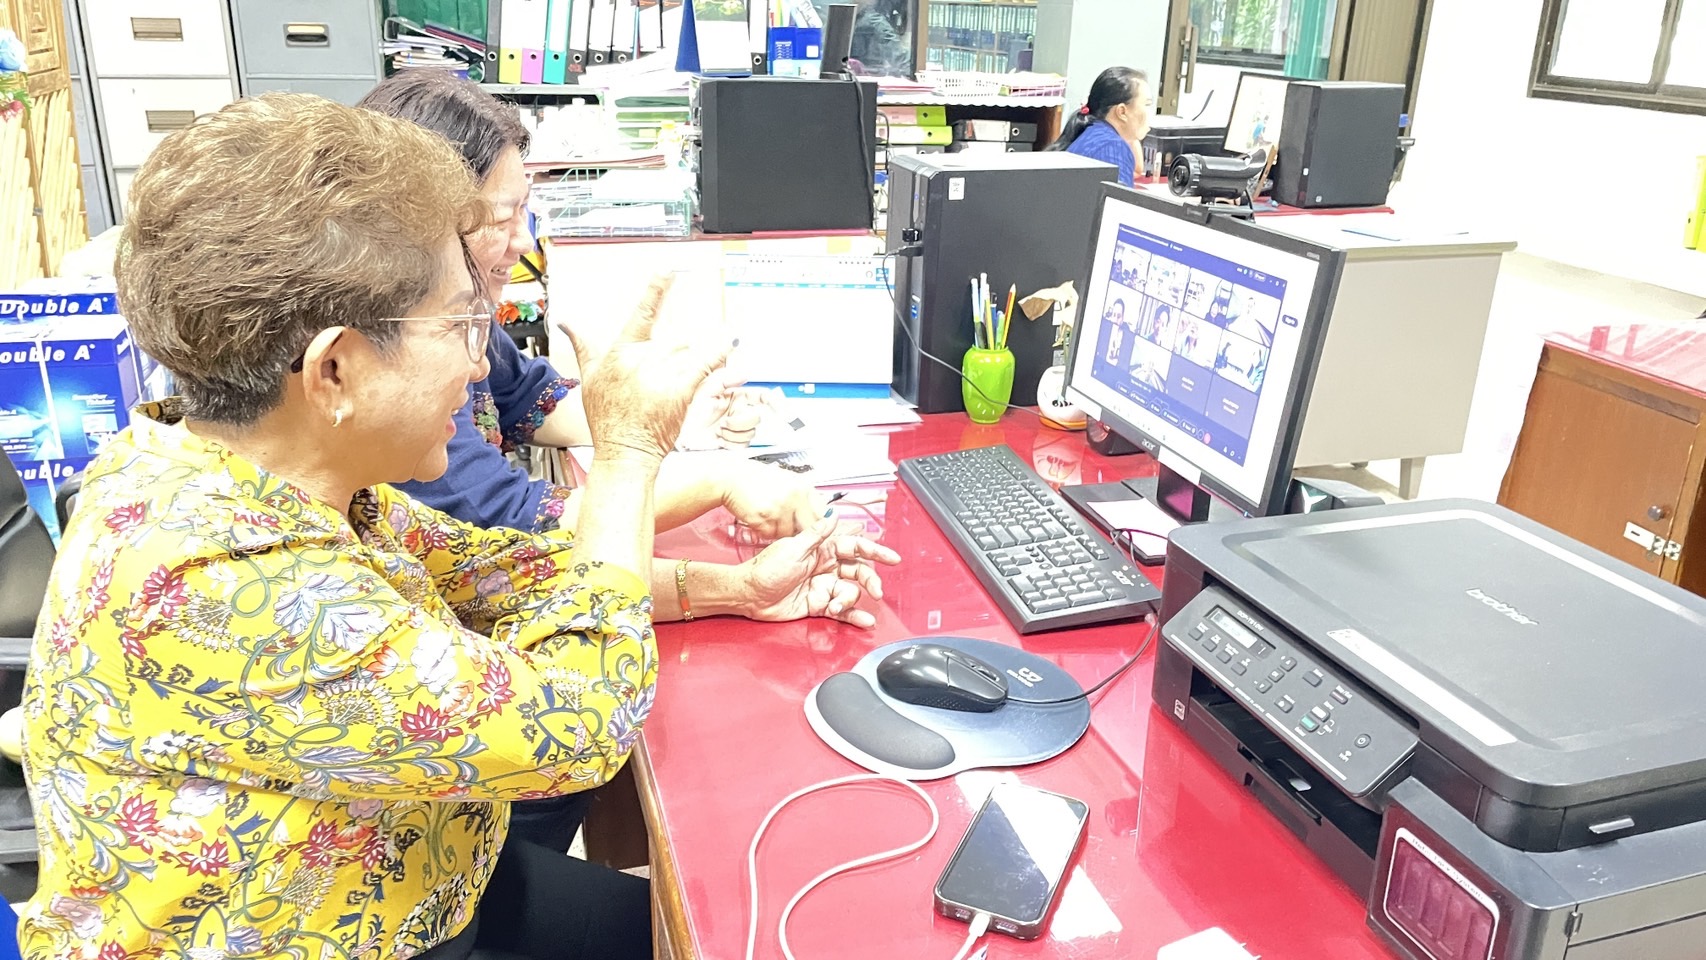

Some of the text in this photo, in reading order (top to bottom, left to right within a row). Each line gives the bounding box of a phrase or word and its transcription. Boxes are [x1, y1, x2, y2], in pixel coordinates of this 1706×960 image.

[0, 298, 80, 316] Double
[0, 345, 66, 363] ouble
[16, 462, 75, 480] uble
